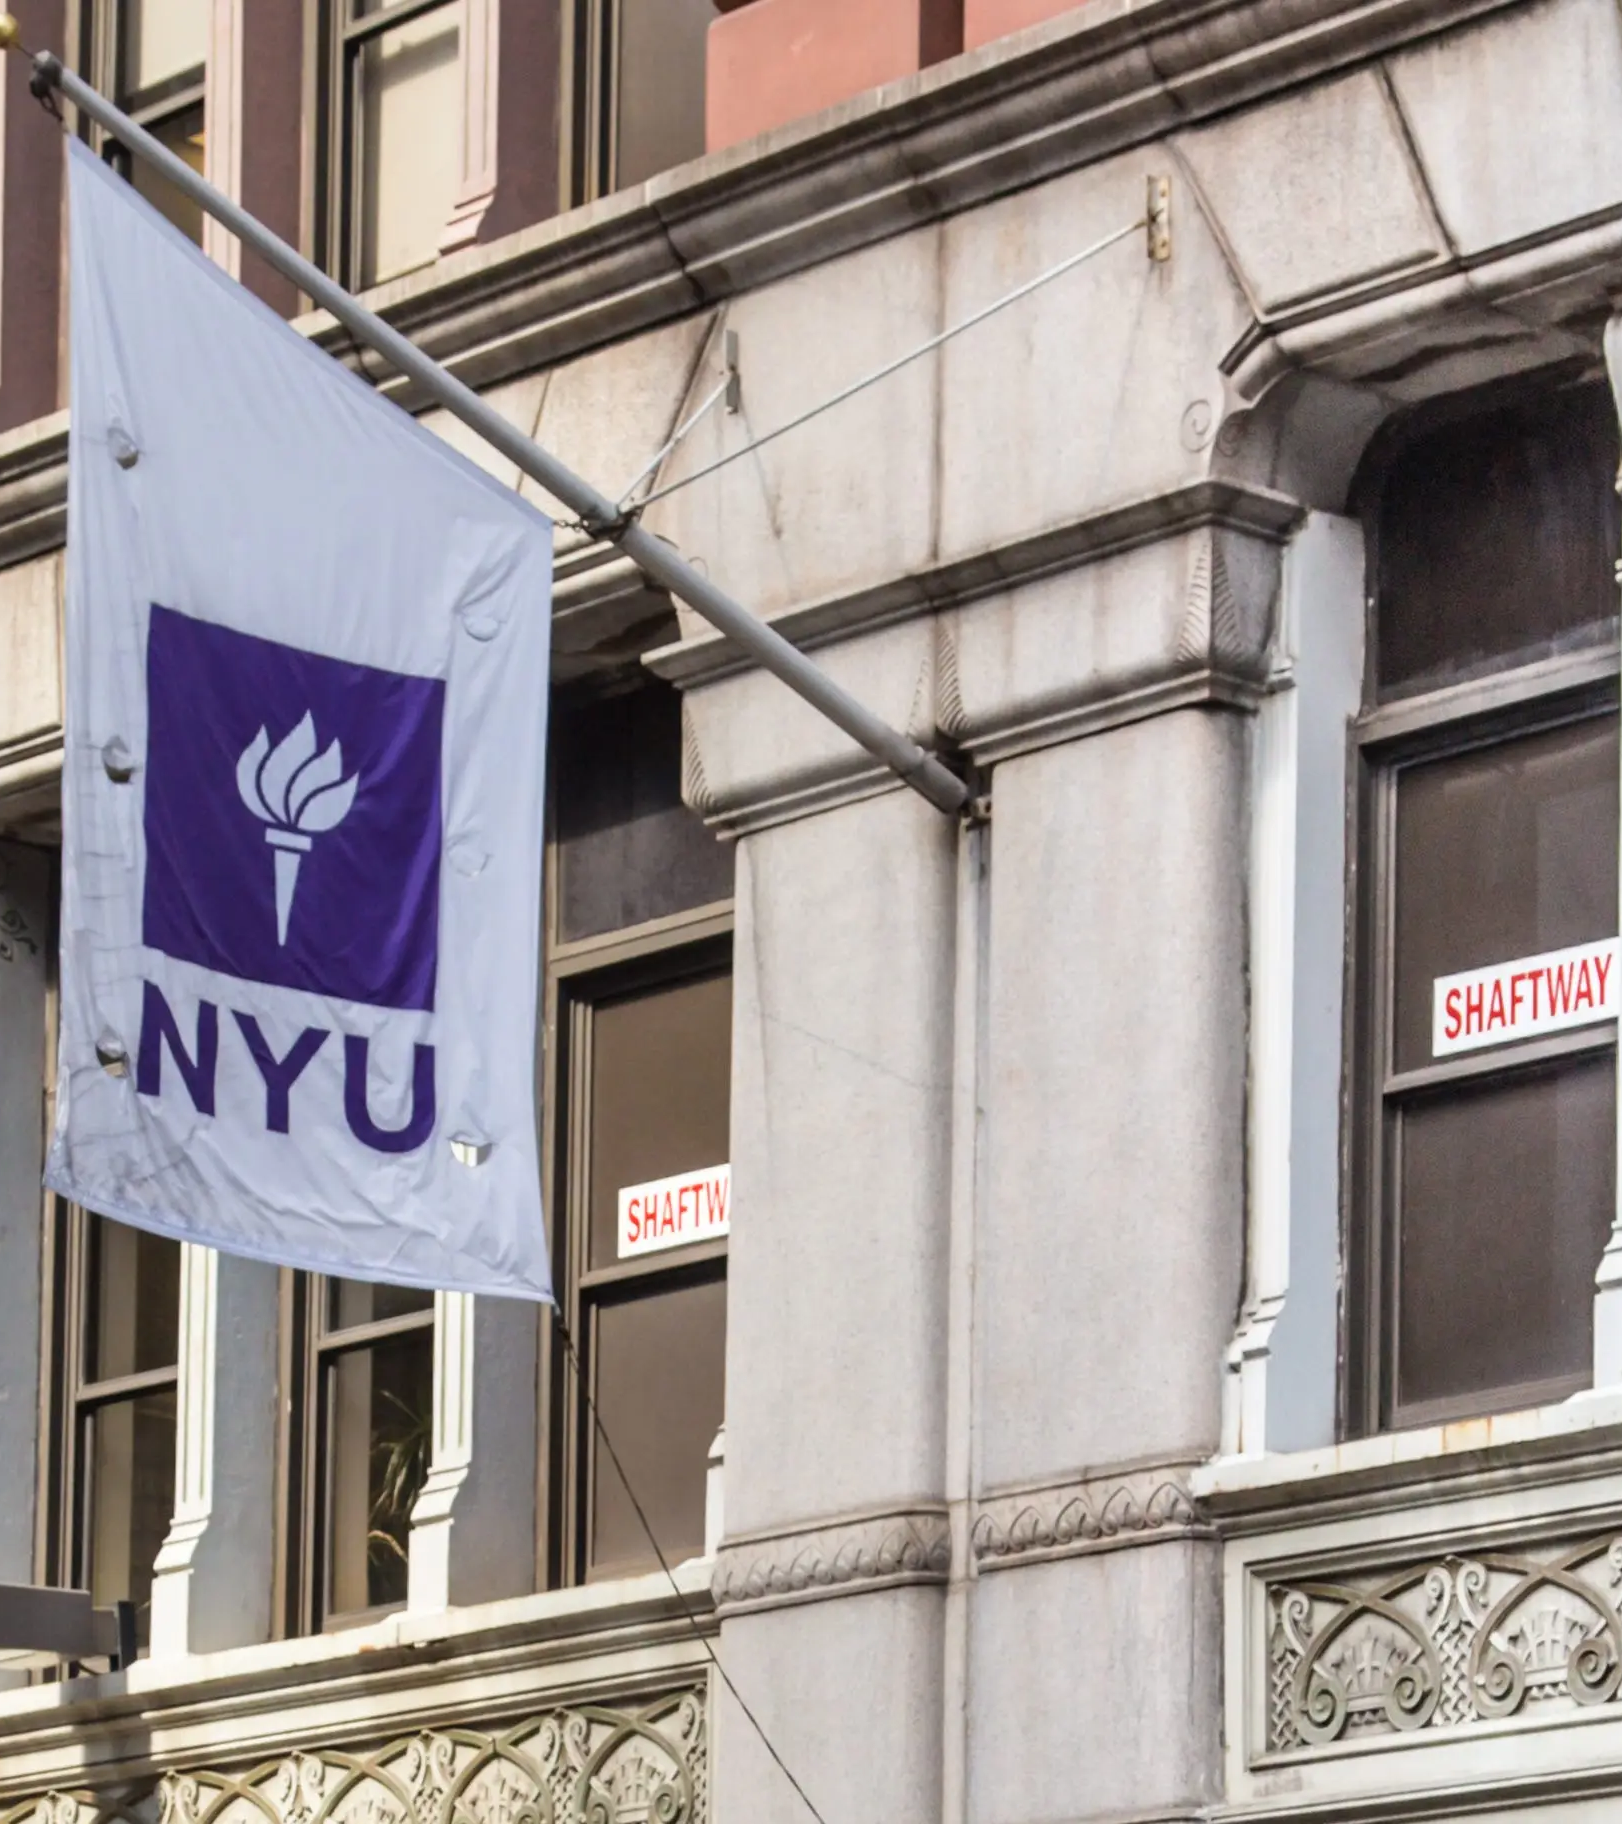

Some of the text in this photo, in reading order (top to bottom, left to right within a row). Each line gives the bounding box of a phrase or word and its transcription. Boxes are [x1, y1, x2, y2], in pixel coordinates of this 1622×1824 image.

[1444, 953, 1613, 1040] SHAFTWAY
[135, 979, 437, 1154] NYU
[627, 1177, 730, 1244] SHAFTW
